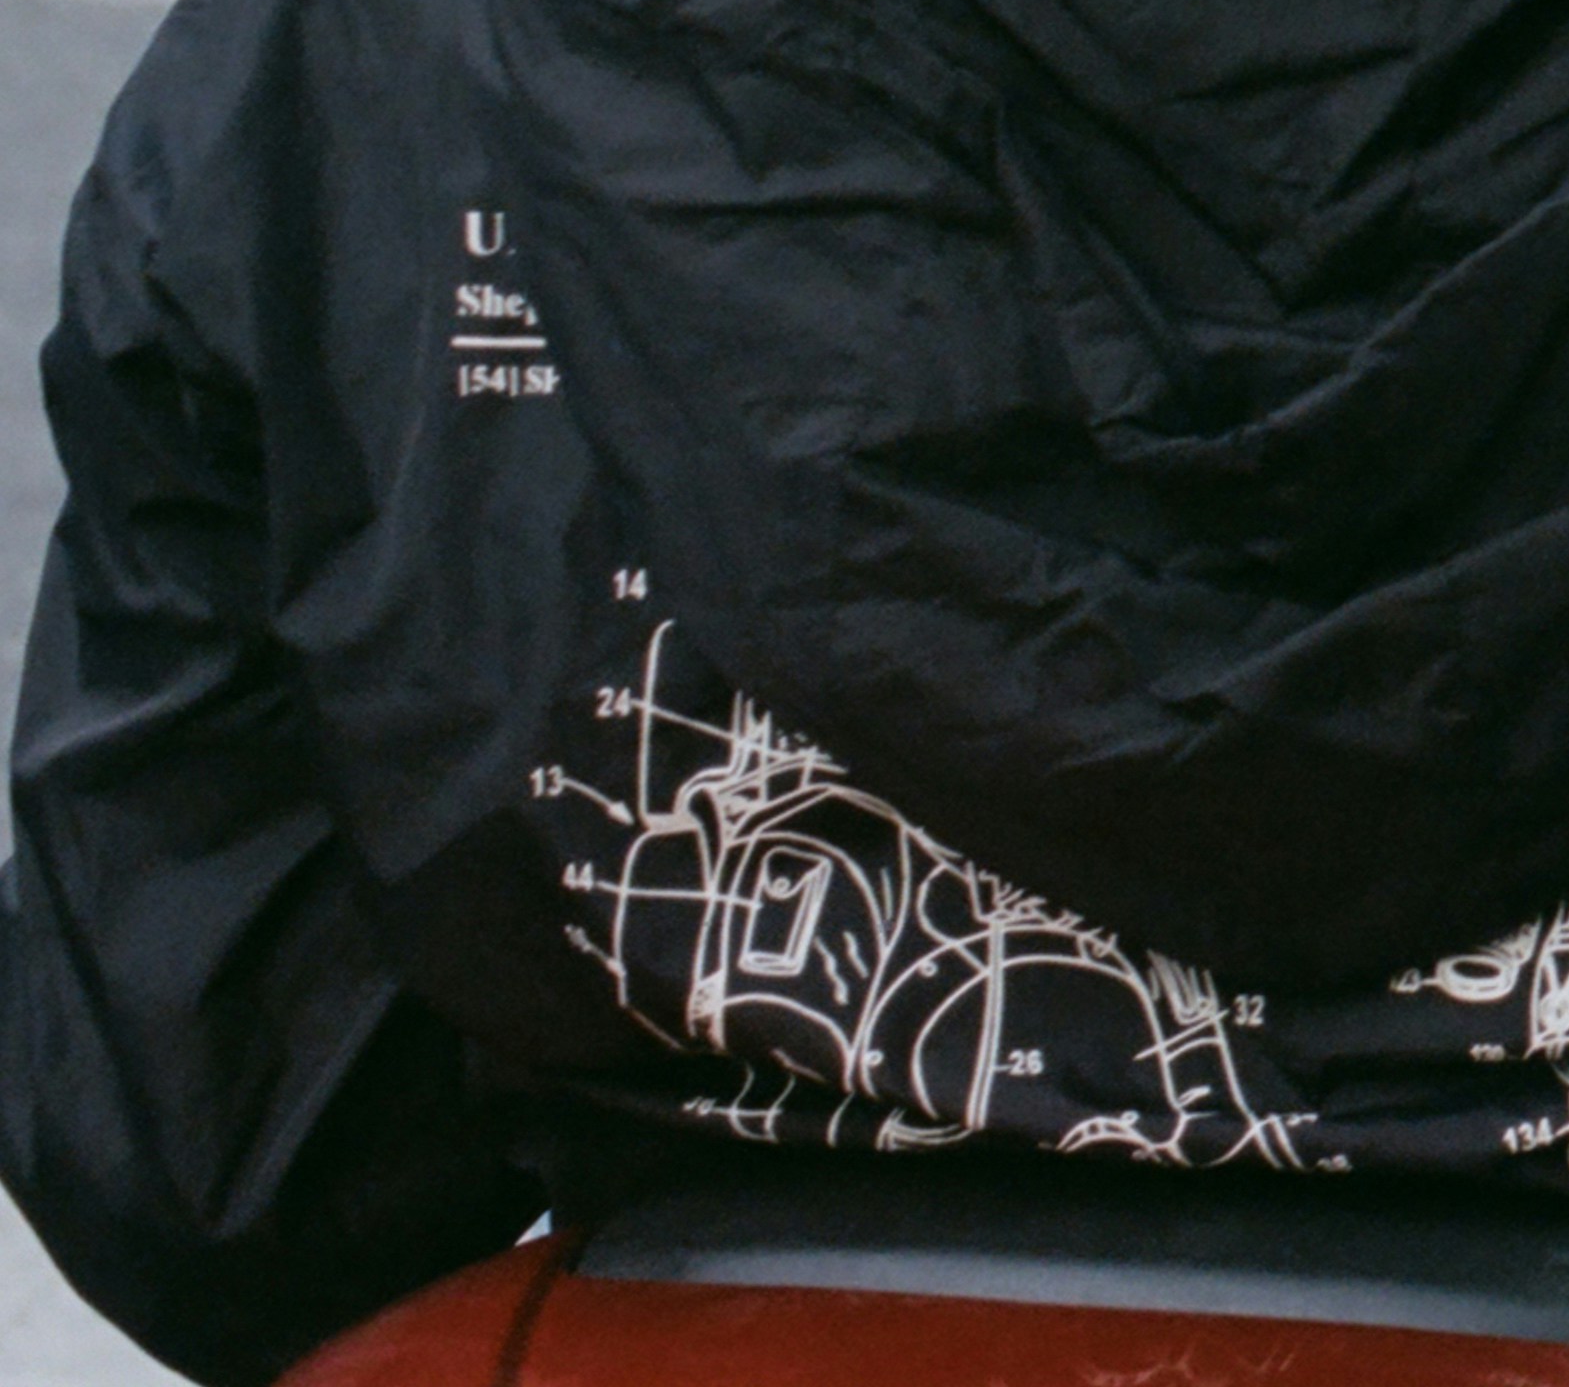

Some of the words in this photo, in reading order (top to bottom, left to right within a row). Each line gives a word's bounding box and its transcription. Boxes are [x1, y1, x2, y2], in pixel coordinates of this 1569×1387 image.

[613, 568, 647, 601] 14
[596, 686, 632, 719] 24
[529, 764, 564, 798] 13
[563, 861, 594, 891] 44
[1234, 993, 1266, 1026] 32
[1008, 1047, 1046, 1076] 26
[1502, 1116, 1553, 1155] 134
